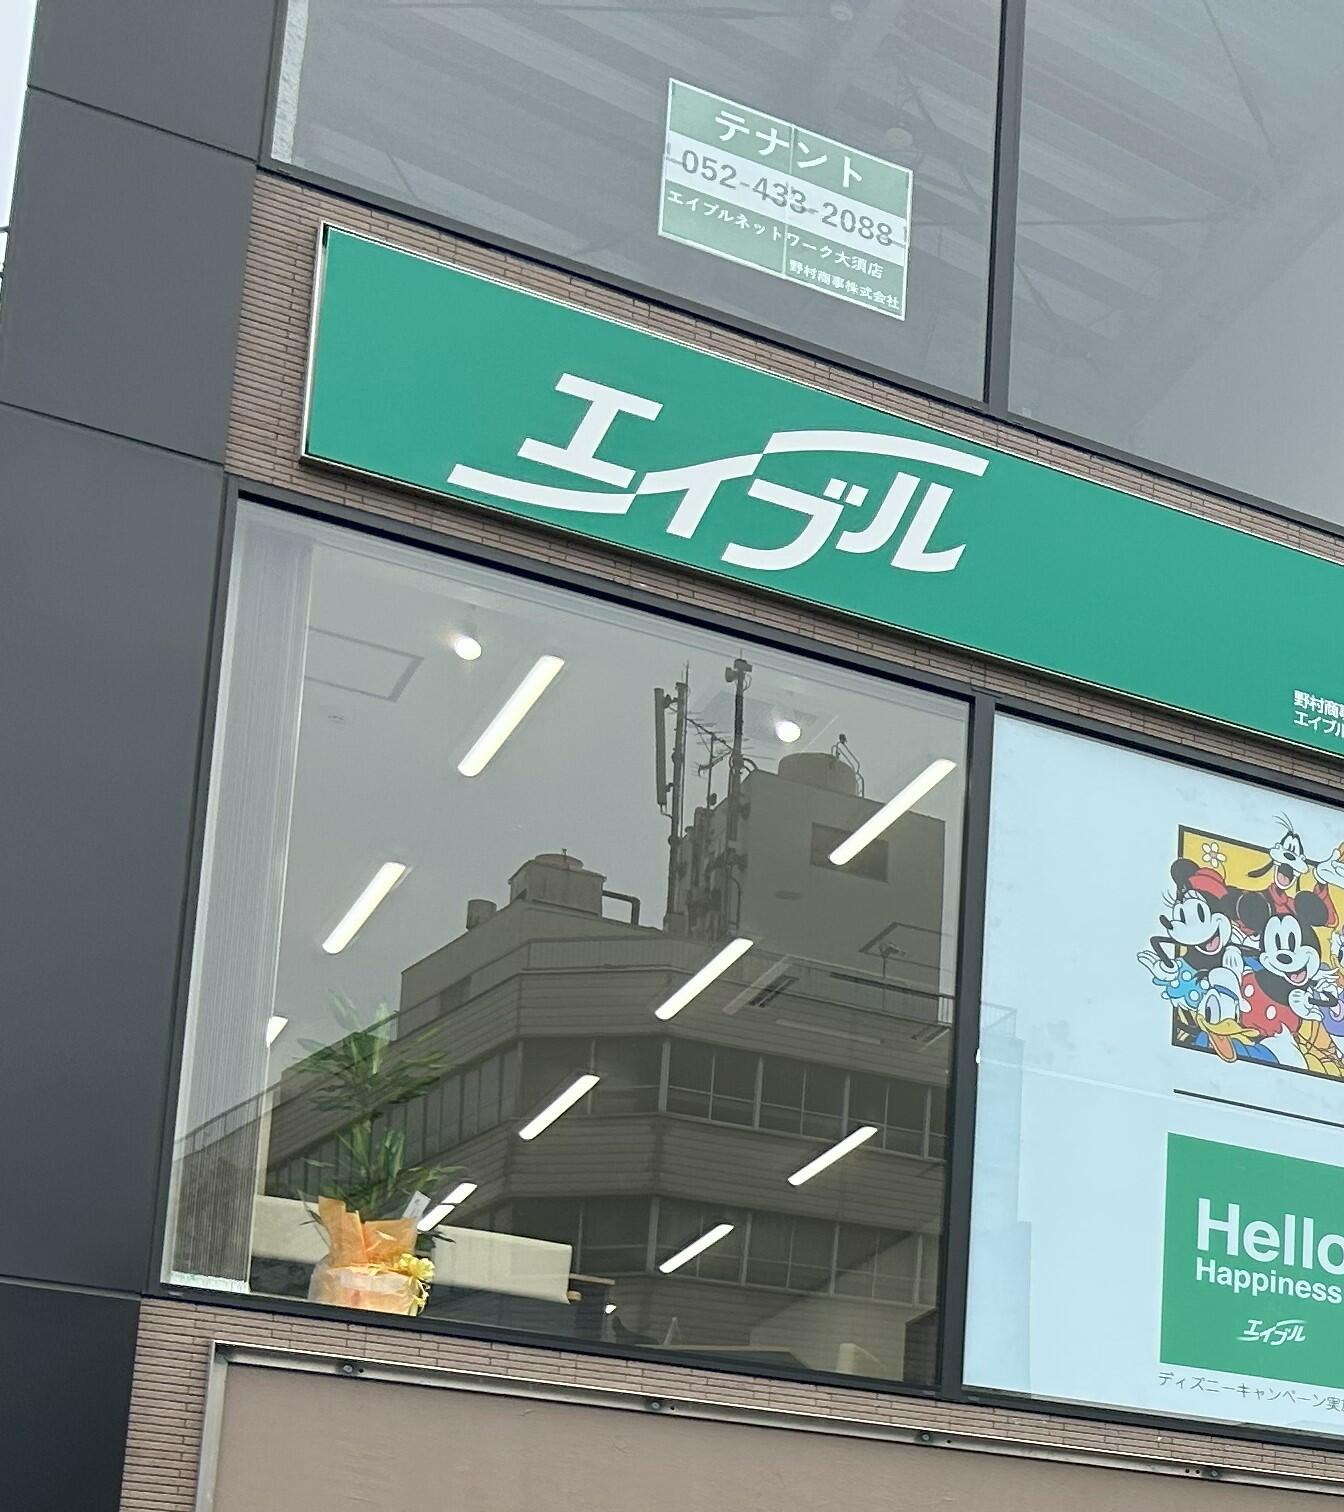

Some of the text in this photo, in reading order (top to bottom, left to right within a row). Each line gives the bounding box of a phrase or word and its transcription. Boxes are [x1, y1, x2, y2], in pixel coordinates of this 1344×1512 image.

[715, 110, 863, 188] テナント
[667, 189, 884, 280] エイブルネットワーク大須店
[681, 149, 893, 247] 052-433-2088
[789, 259, 900, 310] 野村商事株式会社
[446, 372, 990, 573] エイブル
[1236, 1319, 1309, 1346] エイブル
